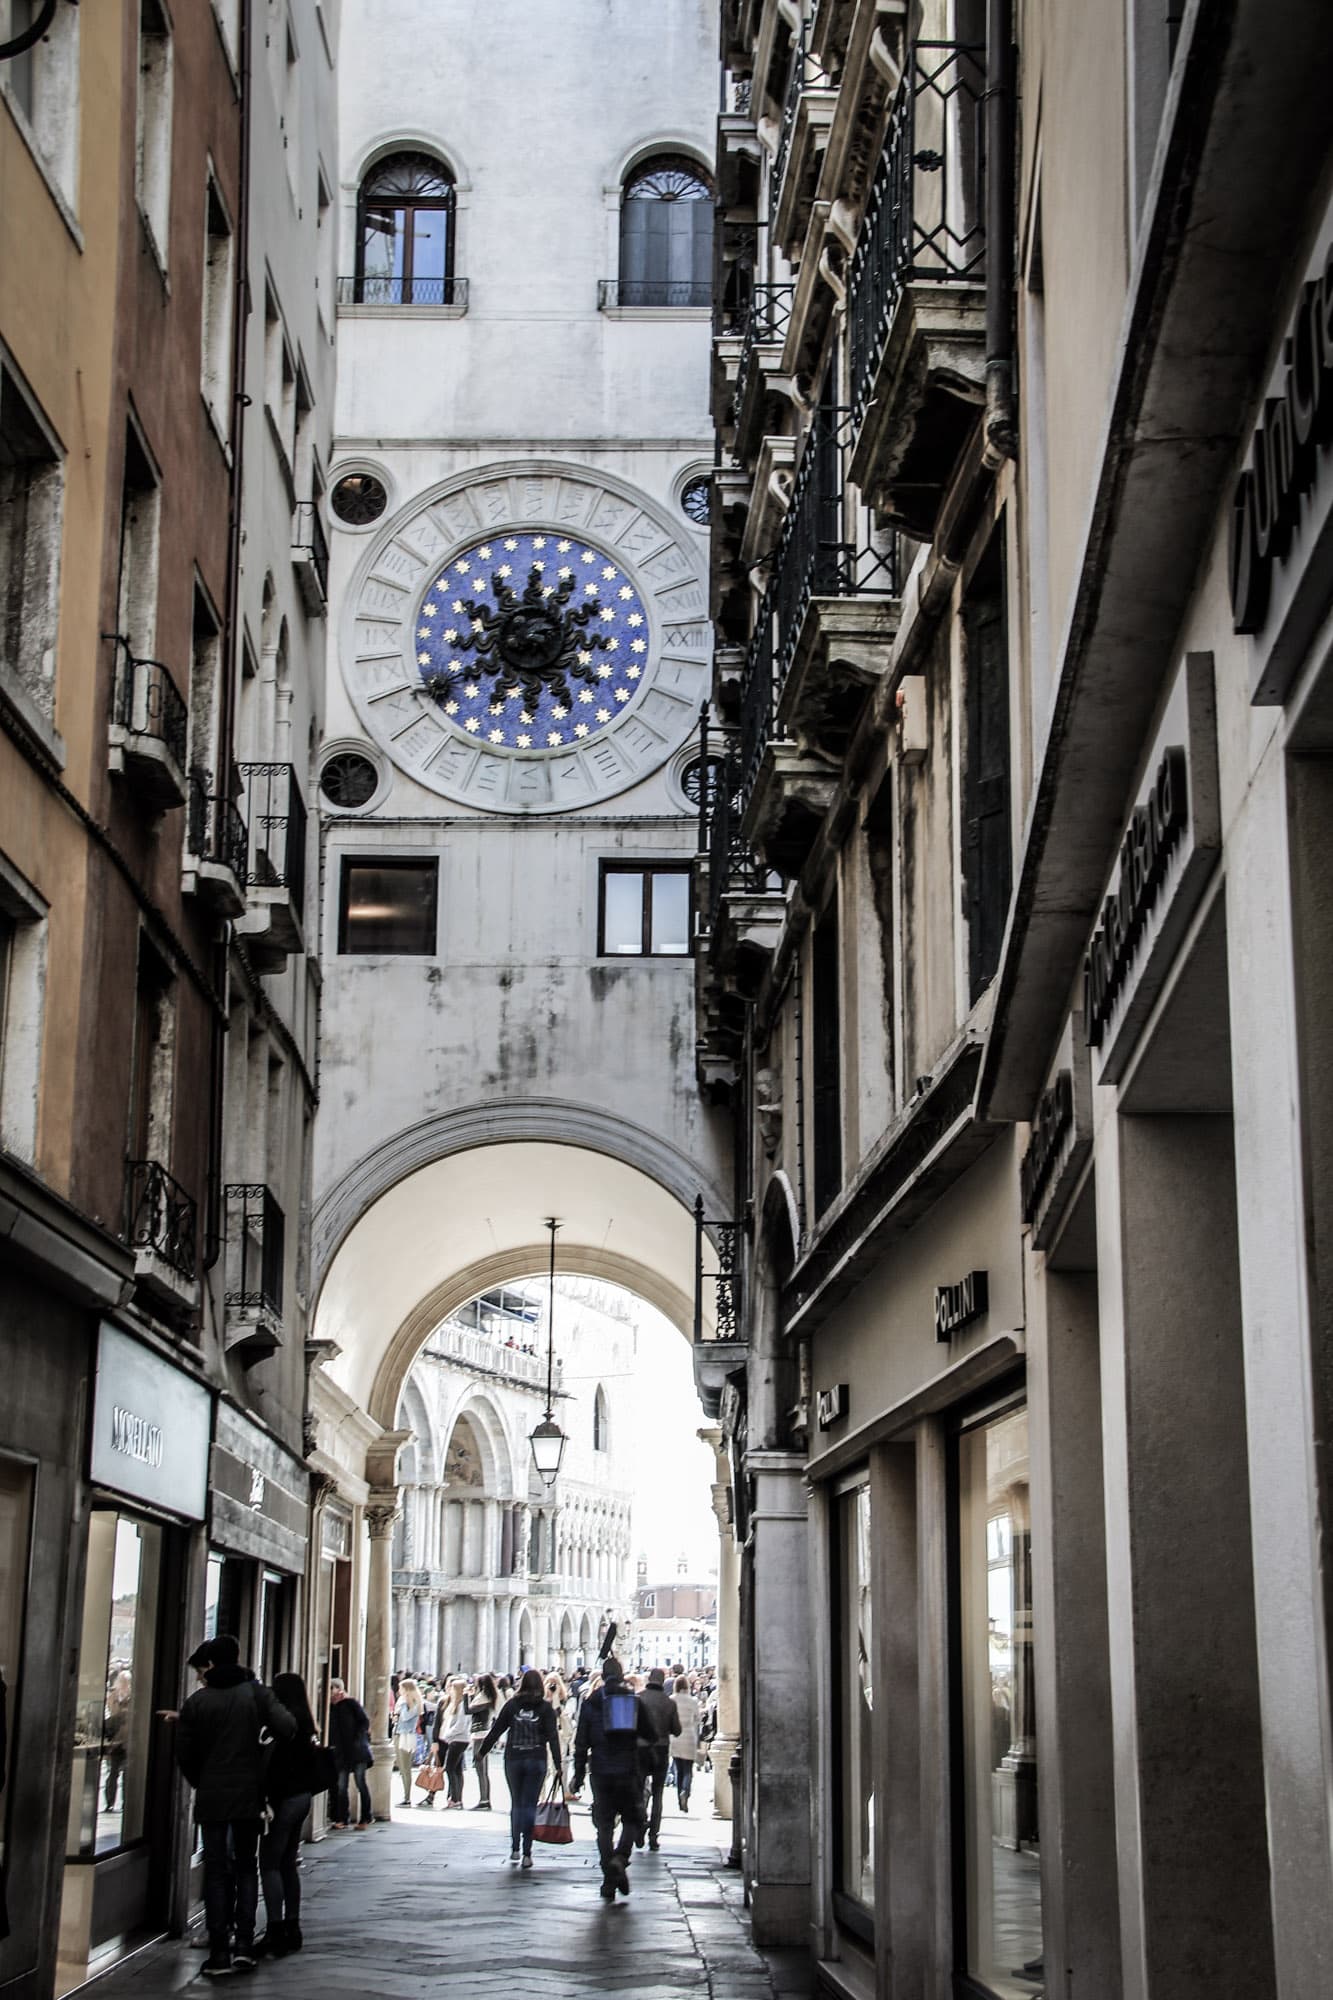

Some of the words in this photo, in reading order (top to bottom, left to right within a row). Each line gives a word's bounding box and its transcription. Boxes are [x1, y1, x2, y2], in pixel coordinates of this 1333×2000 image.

[560, 766, 580, 780] V
[592, 749, 622, 779] IIII
[519, 766, 538, 791] VI
[111, 1404, 164, 1469] MORELLATO
